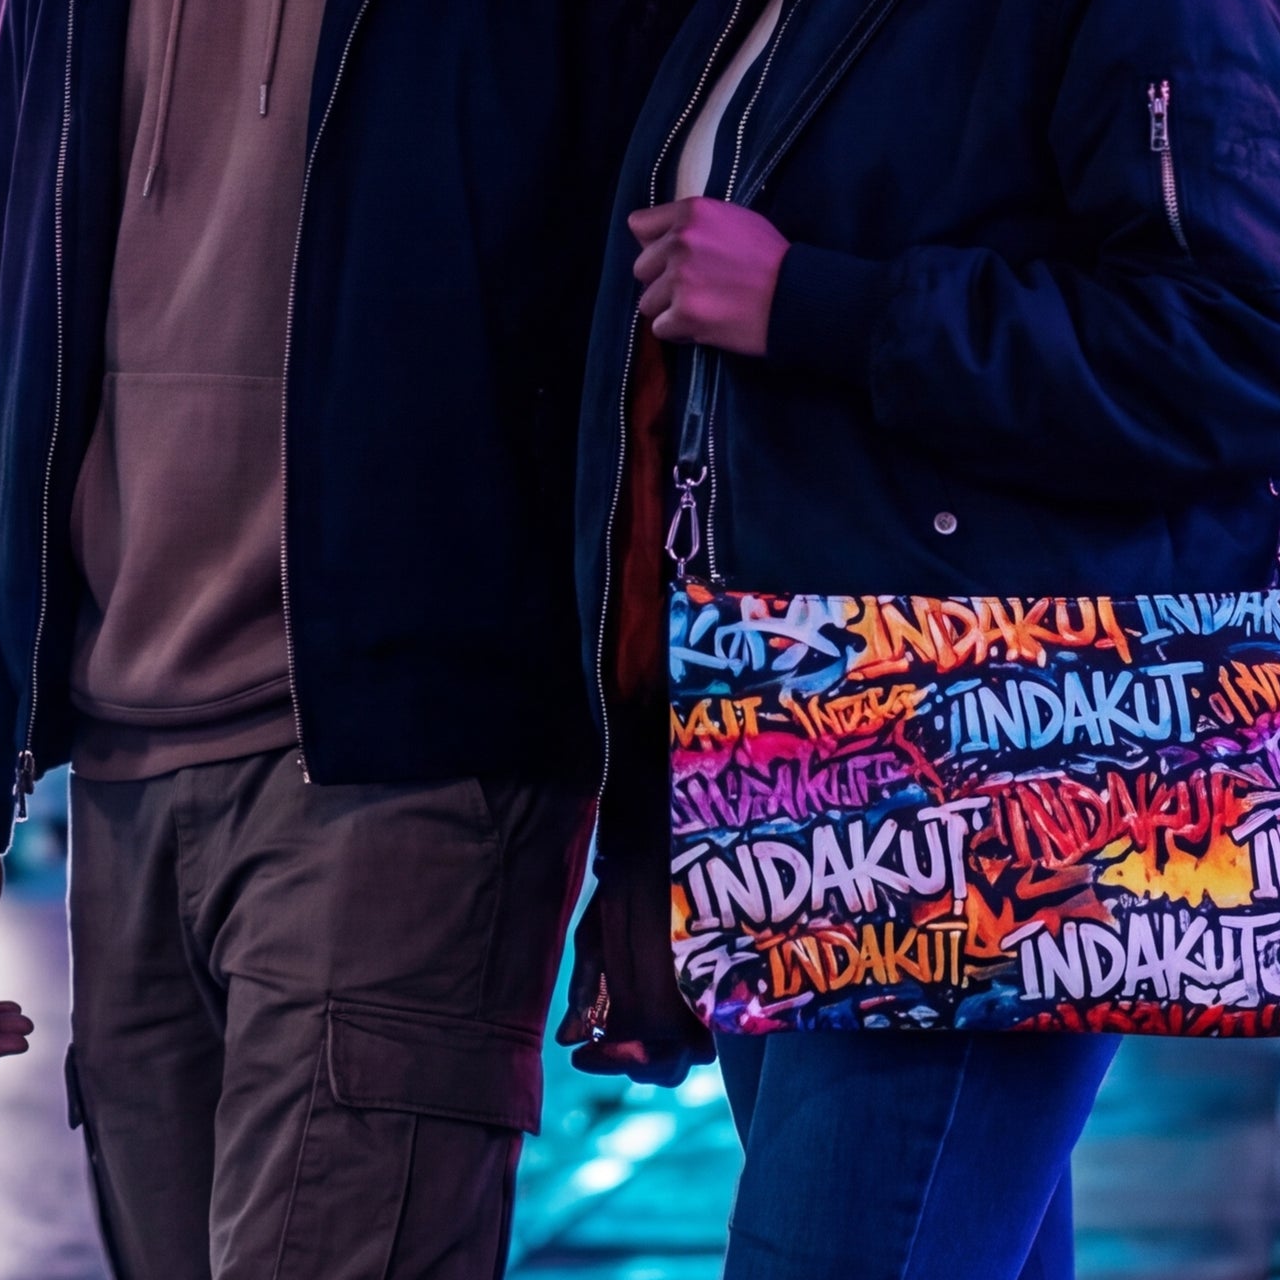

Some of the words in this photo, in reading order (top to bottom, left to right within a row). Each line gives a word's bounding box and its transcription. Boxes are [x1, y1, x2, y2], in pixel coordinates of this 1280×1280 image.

[946, 661, 1204, 754] INDAKUT
[671, 797, 991, 931] INDAKUT
[756, 921, 969, 999] INDAKUT
